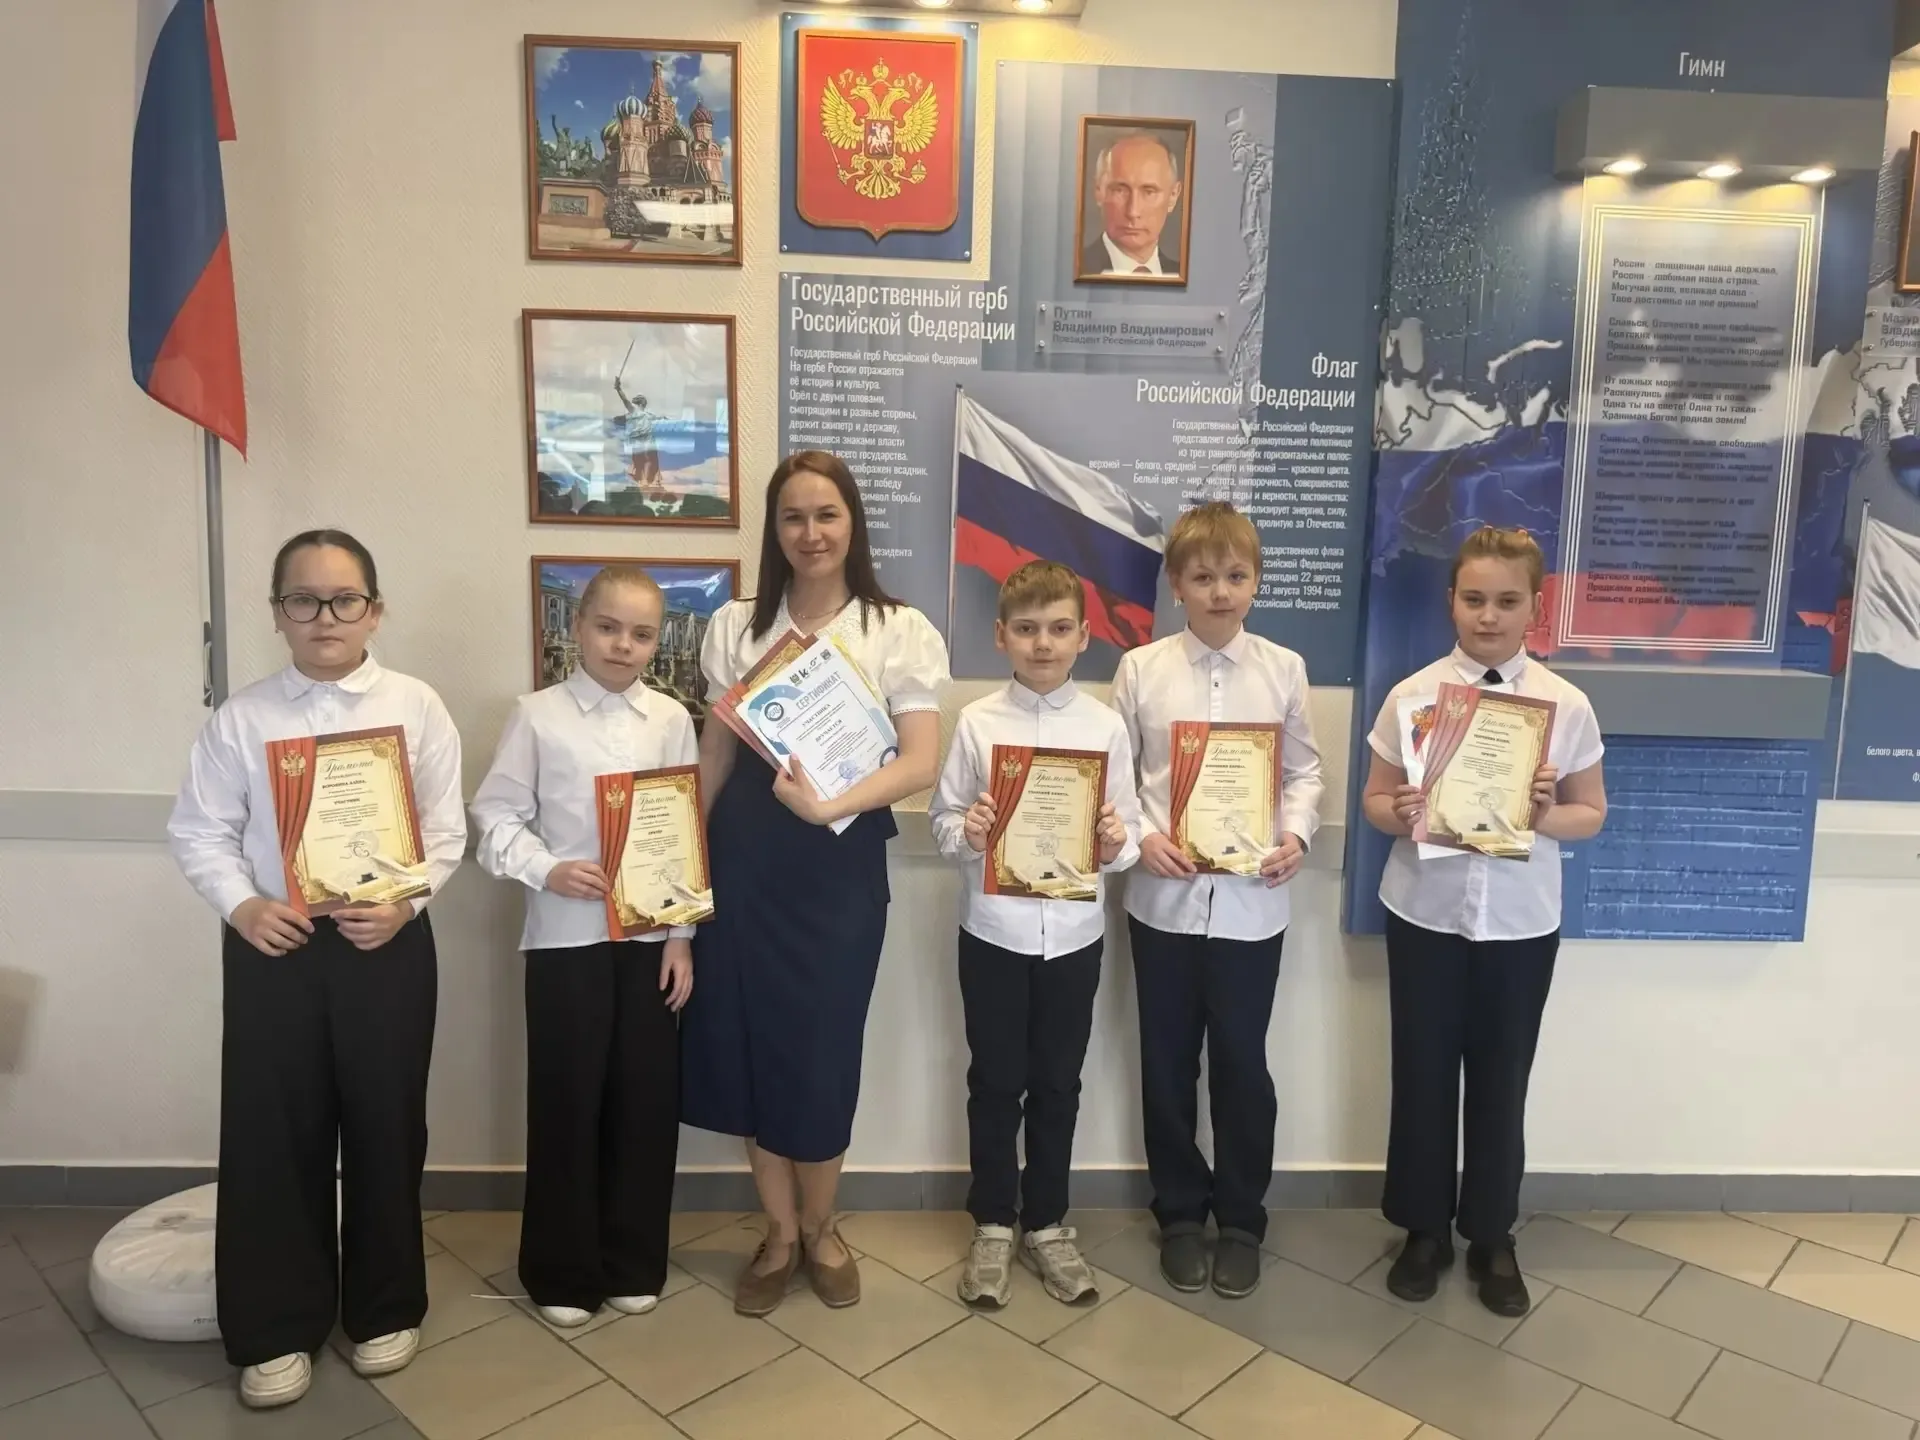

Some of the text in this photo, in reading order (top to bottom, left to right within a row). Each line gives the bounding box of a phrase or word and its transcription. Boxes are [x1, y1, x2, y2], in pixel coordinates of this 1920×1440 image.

[1679, 52, 1725, 77] Гимн
[1613, 258, 1645, 268] Россия
[1708, 264, 1732, 273] наша
[1612, 270, 1644, 280] Россия
[1654, 273, 1696, 283] любимая
[1699, 276, 1722, 284] наша
[1611, 282, 1650, 293] Могучая
[791, 276, 1008, 314] Государственный герб
[1054, 307, 1092, 320] Путин
[1882, 312, 1919, 324] Мазур
[792, 307, 1015, 343] Российской Федерации
[1053, 321, 1214, 337] Владимир Владимирович
[1053, 335, 1206, 348] Президент Российской Федерации
[790, 346, 978, 366] Государственный герб Российской Федерации
[790, 363, 904, 376] На гербе России отражается
[1312, 352, 1358, 378] Флаг
[790, 376, 799, 385] её
[801, 379, 833, 388] история
[844, 380, 880, 391] культура.
[1619, 377, 1652, 386] южных
[790, 389, 886, 405] Орёл с двумя головами,
[1137, 379, 1355, 411] Российской Федерации
[1604, 387, 1662, 399] Раскинулись
[1603, 399, 1625, 409] Одна
[1689, 402, 1711, 412] Одна
[789, 405, 917, 421] смотрящими в разные стороны,
[1602, 410, 1747, 425] Хранимая Богом родная земля!
[789, 419, 899, 434] держит скипетр и державу,
[1172, 419, 1353, 434] Государственный Российской Федерации
[789, 434, 904, 447] являющиеся знаками власти
[1172, 435, 1352, 447] представляет собой прямоугольное полотнище
[836, 451, 856, 459] всего
[859, 450, 908, 461] государства.
[1208, 450, 1261, 460] равновеликих
[1264, 451, 1325, 460] горизонтальных
[849, 463, 928, 476] изображен всадник,
[1089, 459, 1350, 475] верхней белого, средней синего и нижней красного цвета.
[874, 478, 902, 489] победу
[1134, 473, 1159, 484] Белый
[1162, 475, 1178, 485] цвет
[1239, 478, 1291, 487] непорочность,
[860, 491, 920, 504] символ борьбы
[1182, 490, 1204, 498] синий
[1213, 490, 1230, 500] цвет
[1233, 492, 1252, 501] веры
[1262, 492, 1298, 502] верности,
[1292, 506, 1325, 515] энергию,
[1327, 507, 1347, 517] силу,
[1257, 519, 1293, 528] пролитую
[1306, 518, 1346, 529] Отечество.
[1261, 546, 1344, 558] сударственного флага
[1263, 558, 1343, 571] ссийской Федерации
[1263, 572, 1342, 584] ежегодно 22 августа.
[1260, 584, 1341, 596] 20 августа 1994 года
[1295, 598, 1340, 611] Федерации.
[796, 670, 841, 710] СЕРТИФИКАТ
[815, 720, 843, 742] ВРУЧАЕТСЯ
[1867, 746, 1890, 756] белого
[1893, 748, 1914, 757] цвета,
